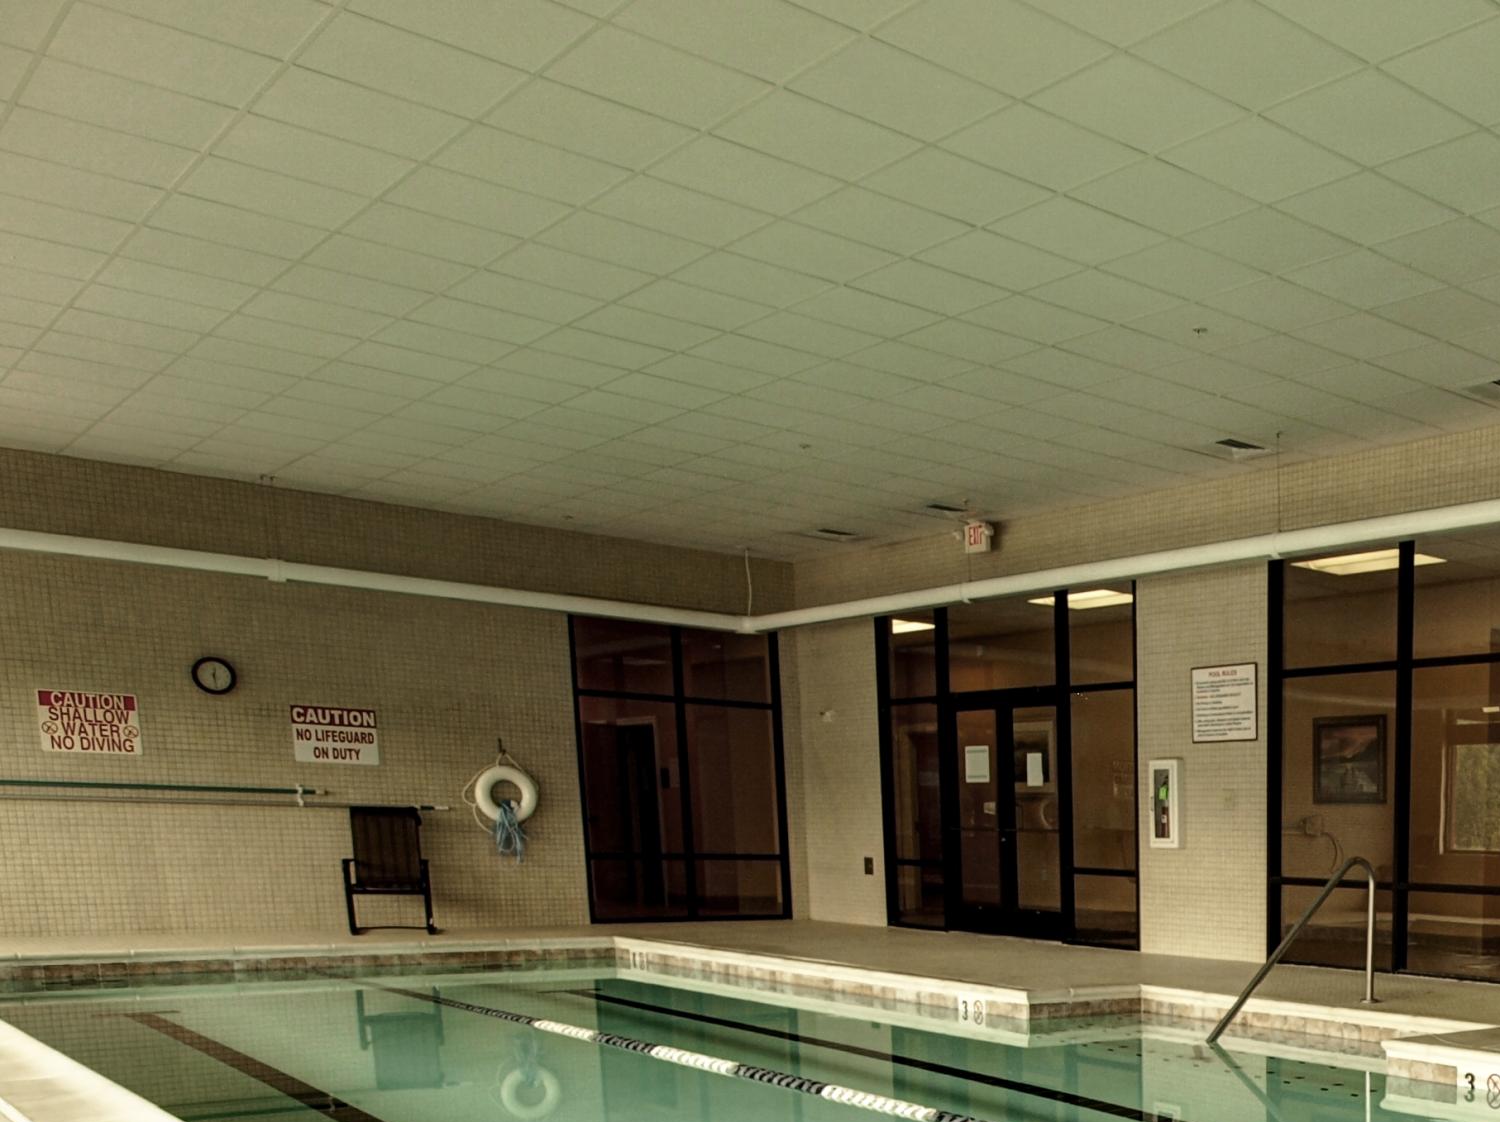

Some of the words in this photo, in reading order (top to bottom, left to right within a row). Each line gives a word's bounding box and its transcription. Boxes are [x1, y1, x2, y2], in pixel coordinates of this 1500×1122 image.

[969, 525, 983, 546] EXIT
[51, 692, 124, 711] CAUTION
[48, 706, 129, 724] SHALLOW
[292, 707, 375, 727] CAUTION
[62, 721, 120, 738] WATER
[296, 728, 312, 741] NO
[315, 729, 374, 744] LIFEGUARD
[50, 735, 74, 750] NO
[80, 736, 134, 753] DIVING
[313, 746, 329, 760] ON
[332, 747, 361, 760] DUTY
[1464, 1072, 1475, 1090] 3
